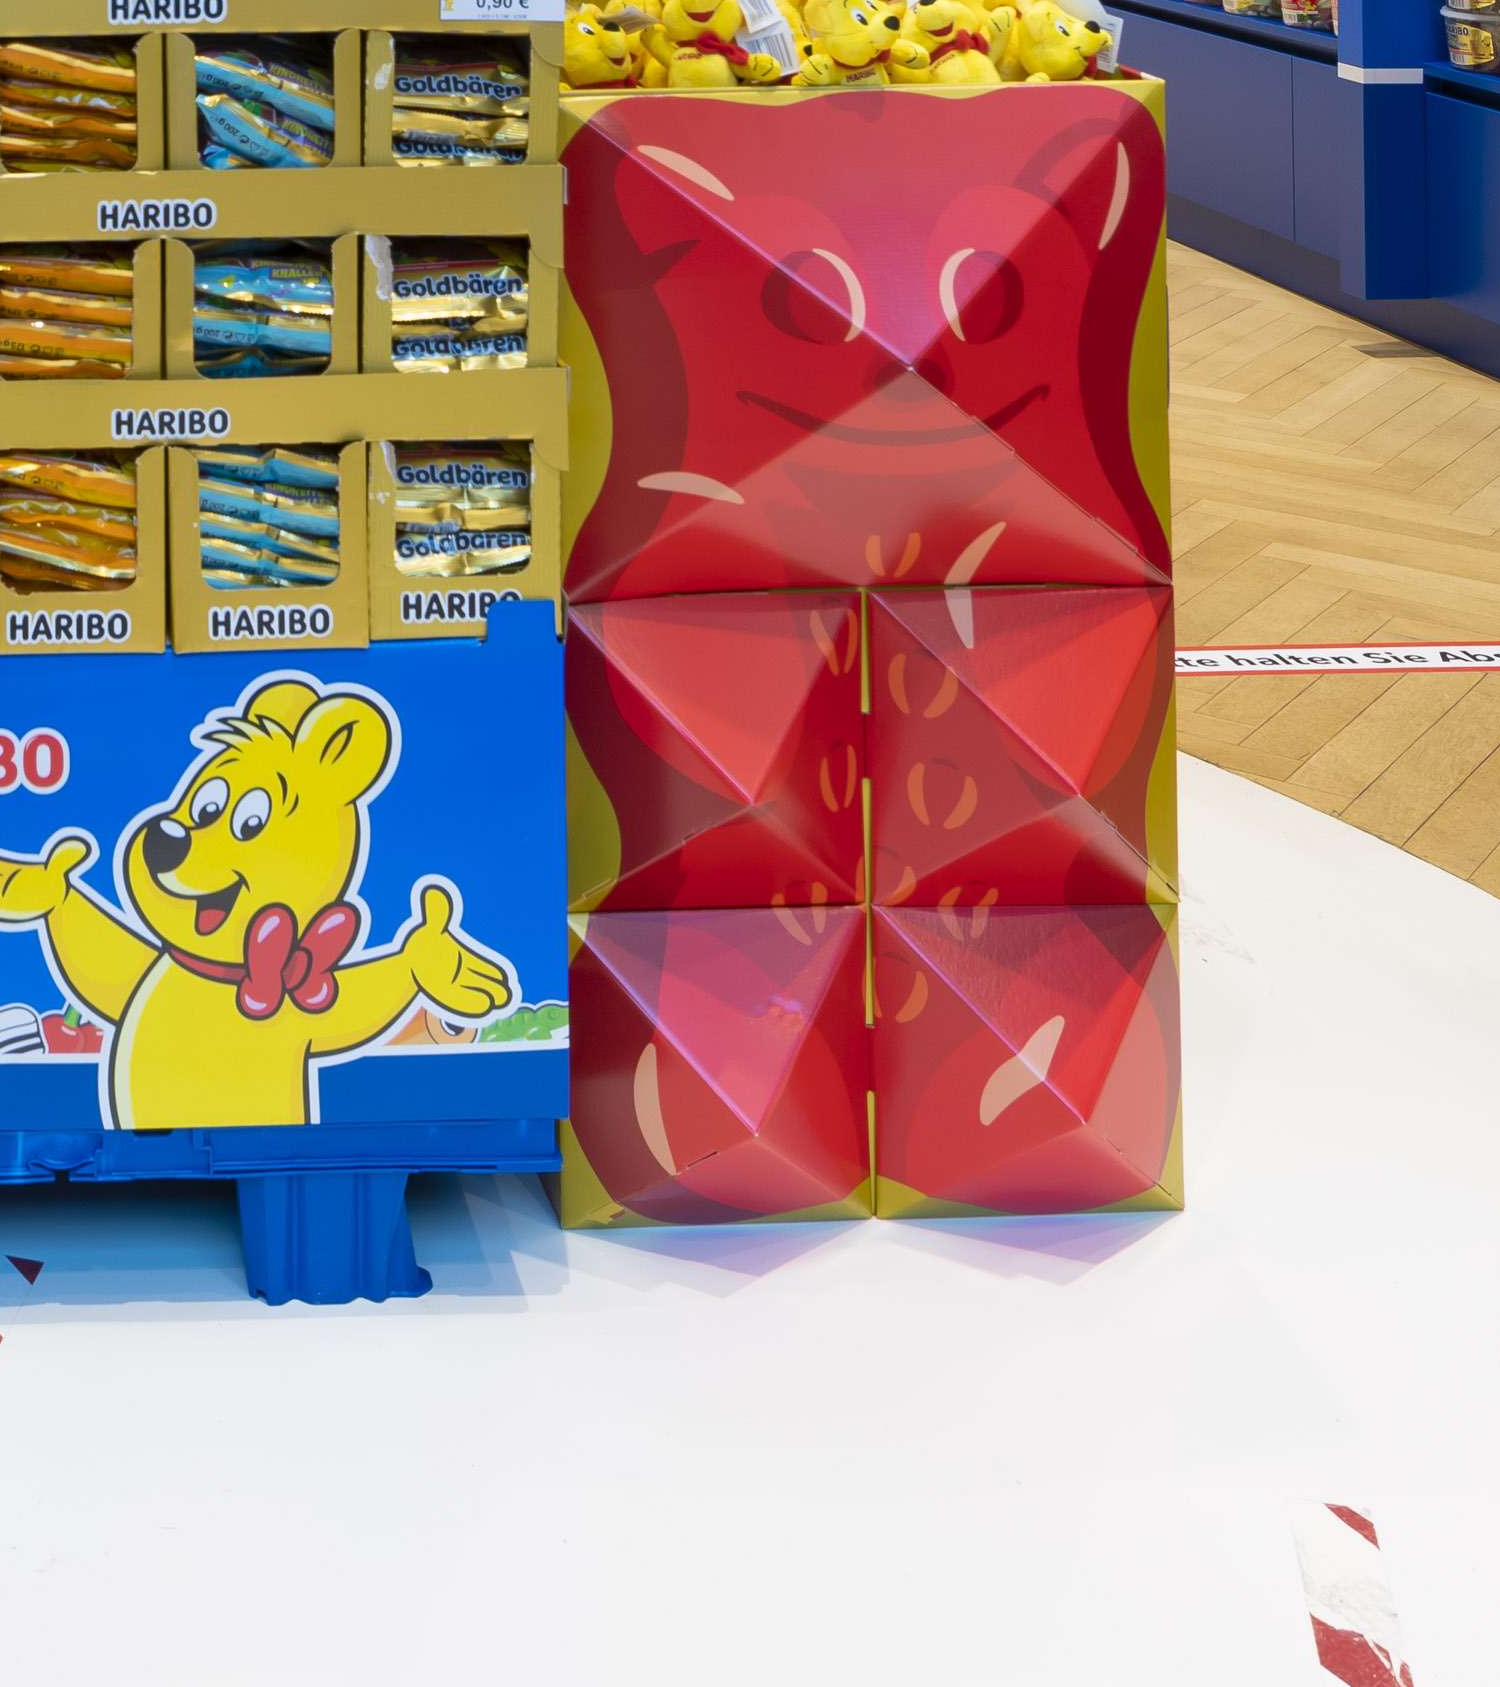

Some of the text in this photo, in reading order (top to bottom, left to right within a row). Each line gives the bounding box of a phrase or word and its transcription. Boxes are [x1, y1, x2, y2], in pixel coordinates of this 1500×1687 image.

[395, 76, 520, 98] Goldbären
[101, 203, 214, 229] HARIBO
[393, 272, 522, 298] Goldbären
[114, 410, 229, 435] HARIBO
[398, 465, 527, 488] Goldbären
[10, 613, 131, 641] HARIBO
[212, 608, 331, 637] HARIBO
[1233, 652, 1349, 668] halten
[1363, 651, 1426, 666] Sie
